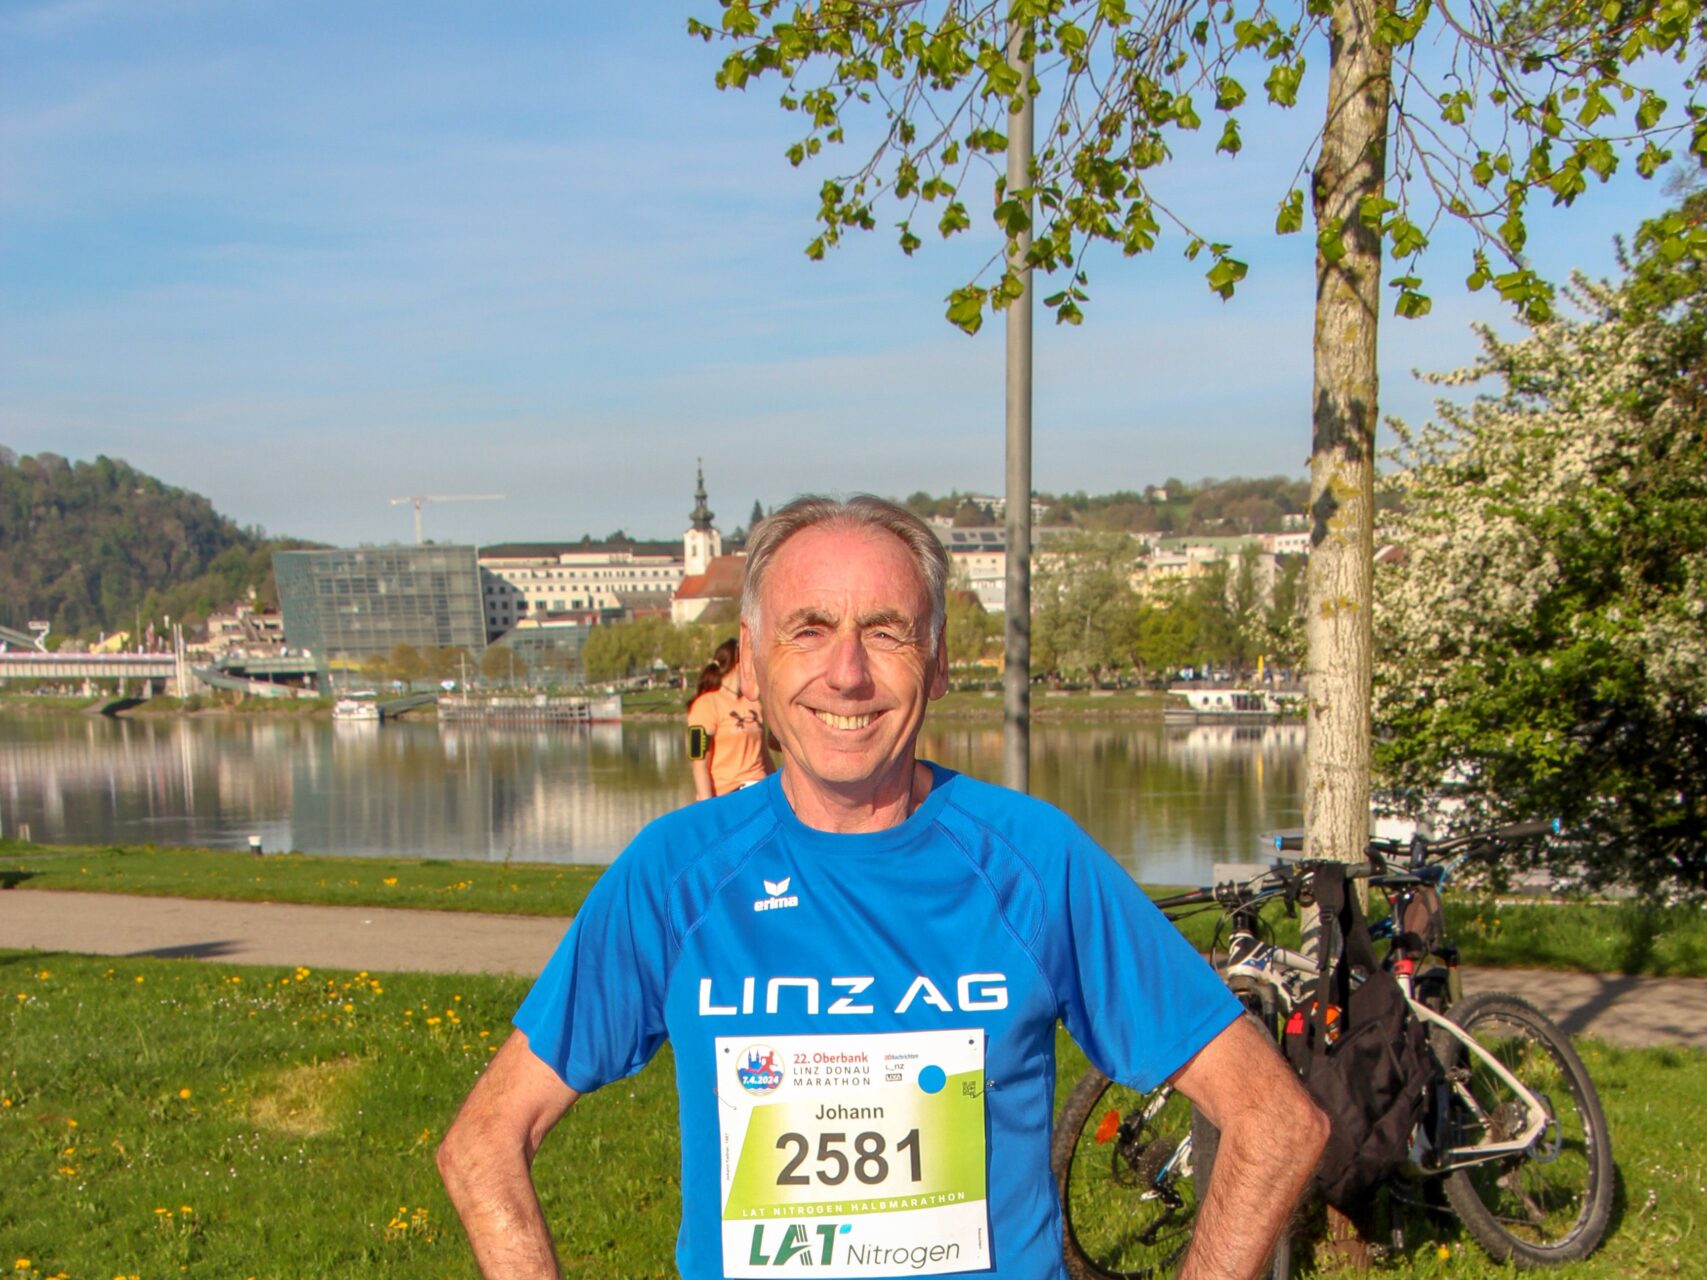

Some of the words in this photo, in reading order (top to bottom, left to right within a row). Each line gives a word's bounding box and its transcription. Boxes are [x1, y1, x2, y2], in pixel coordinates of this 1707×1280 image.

[753, 896, 799, 912] erima
[894, 973, 1009, 1014] AG
[793, 1053, 811, 1064] 22.
[813, 1052, 869, 1064] Oberbank
[793, 1066, 820, 1075] LINZ
[826, 1066, 870, 1075] DONAU
[742, 1075, 780, 1085] 7.4.2024
[793, 1077, 871, 1087] MARATHON
[815, 1104, 885, 1120] Johann
[775, 1128, 922, 1186] 2581
[742, 1208, 766, 1217] LAT
[773, 1204, 843, 1216] NITROGEN
[851, 1191, 966, 1212] HALBMARATHON
[749, 1224, 842, 1266] LAT
[846, 1243, 960, 1269] Nitrogen
